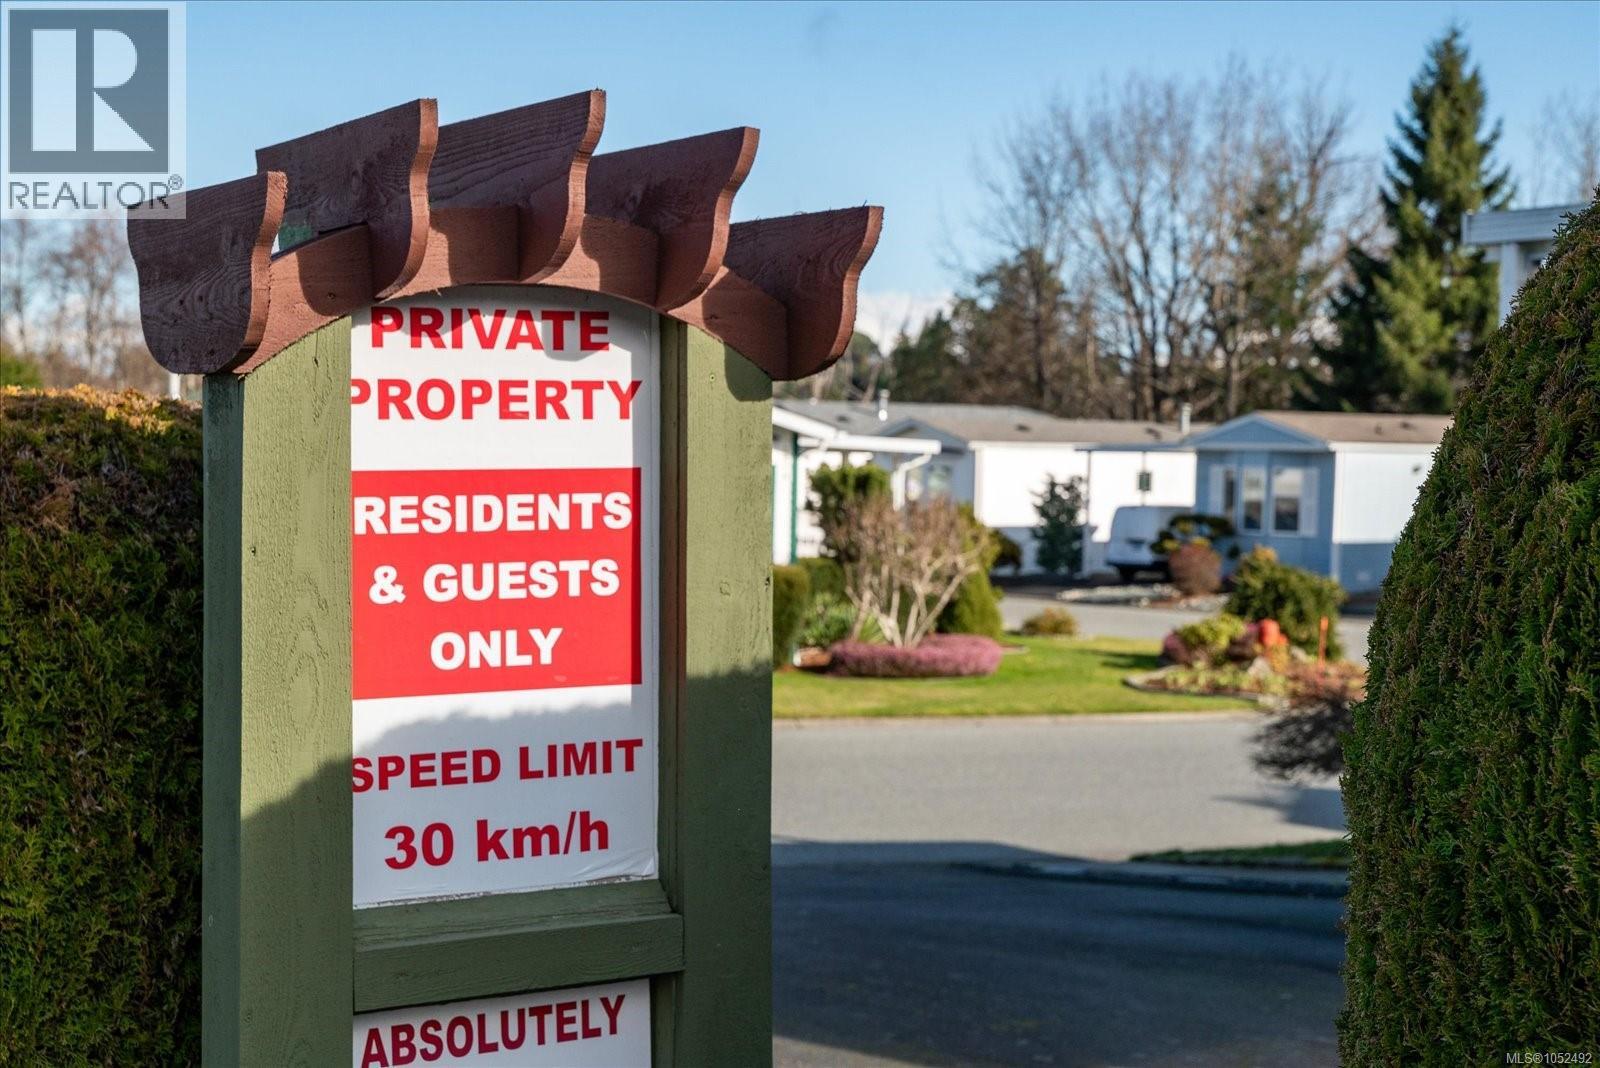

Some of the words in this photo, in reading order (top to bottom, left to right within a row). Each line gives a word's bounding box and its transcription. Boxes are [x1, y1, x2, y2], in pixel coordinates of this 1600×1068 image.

[370, 306, 610, 352] PRIVATE
[353, 492, 633, 535] RESIDENTS
[368, 565, 406, 605] &
[422, 558, 620, 603] GUESTS
[430, 627, 563, 670] ONLY
[352, 748, 501, 793] SPEED
[519, 738, 643, 780] LIMIT
[384, 821, 454, 870] 30
[476, 810, 609, 862] km/h
[360, 994, 625, 1068] ABSOLUTELY
